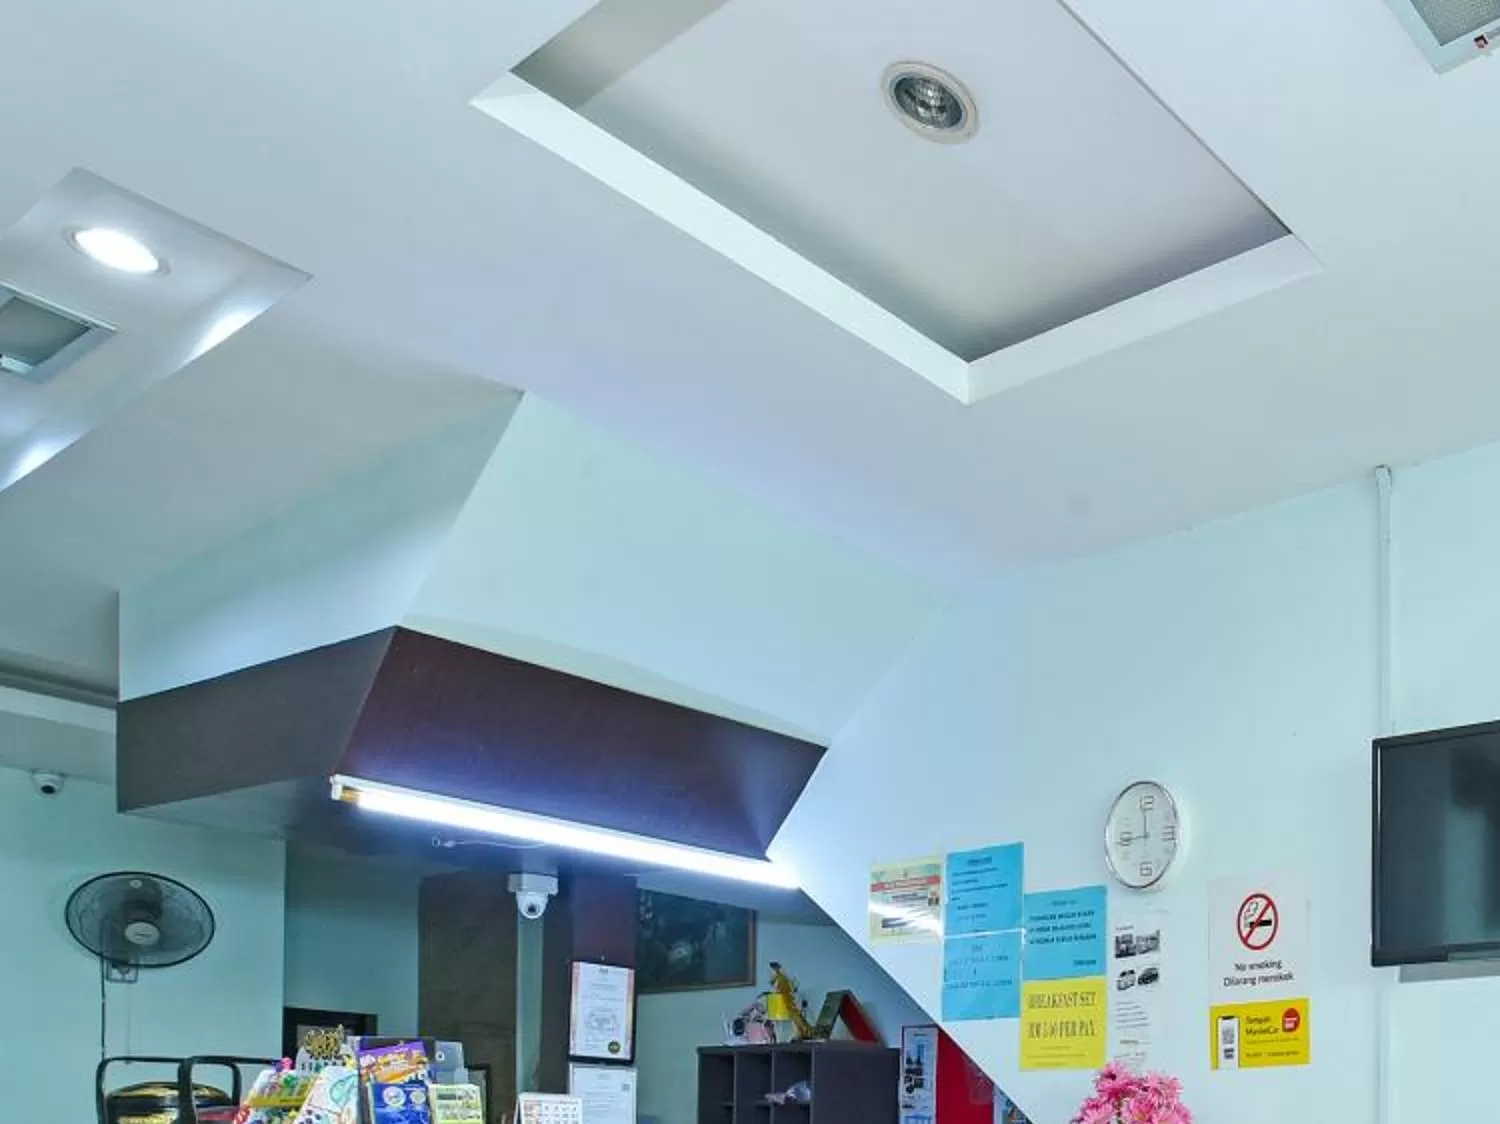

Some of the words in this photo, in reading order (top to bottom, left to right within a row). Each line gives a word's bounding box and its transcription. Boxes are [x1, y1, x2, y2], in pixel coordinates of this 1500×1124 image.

[1235, 963, 1246, 971] No
[1248, 960, 1282, 971] smoking
[1224, 977, 1256, 987] Dilarang
